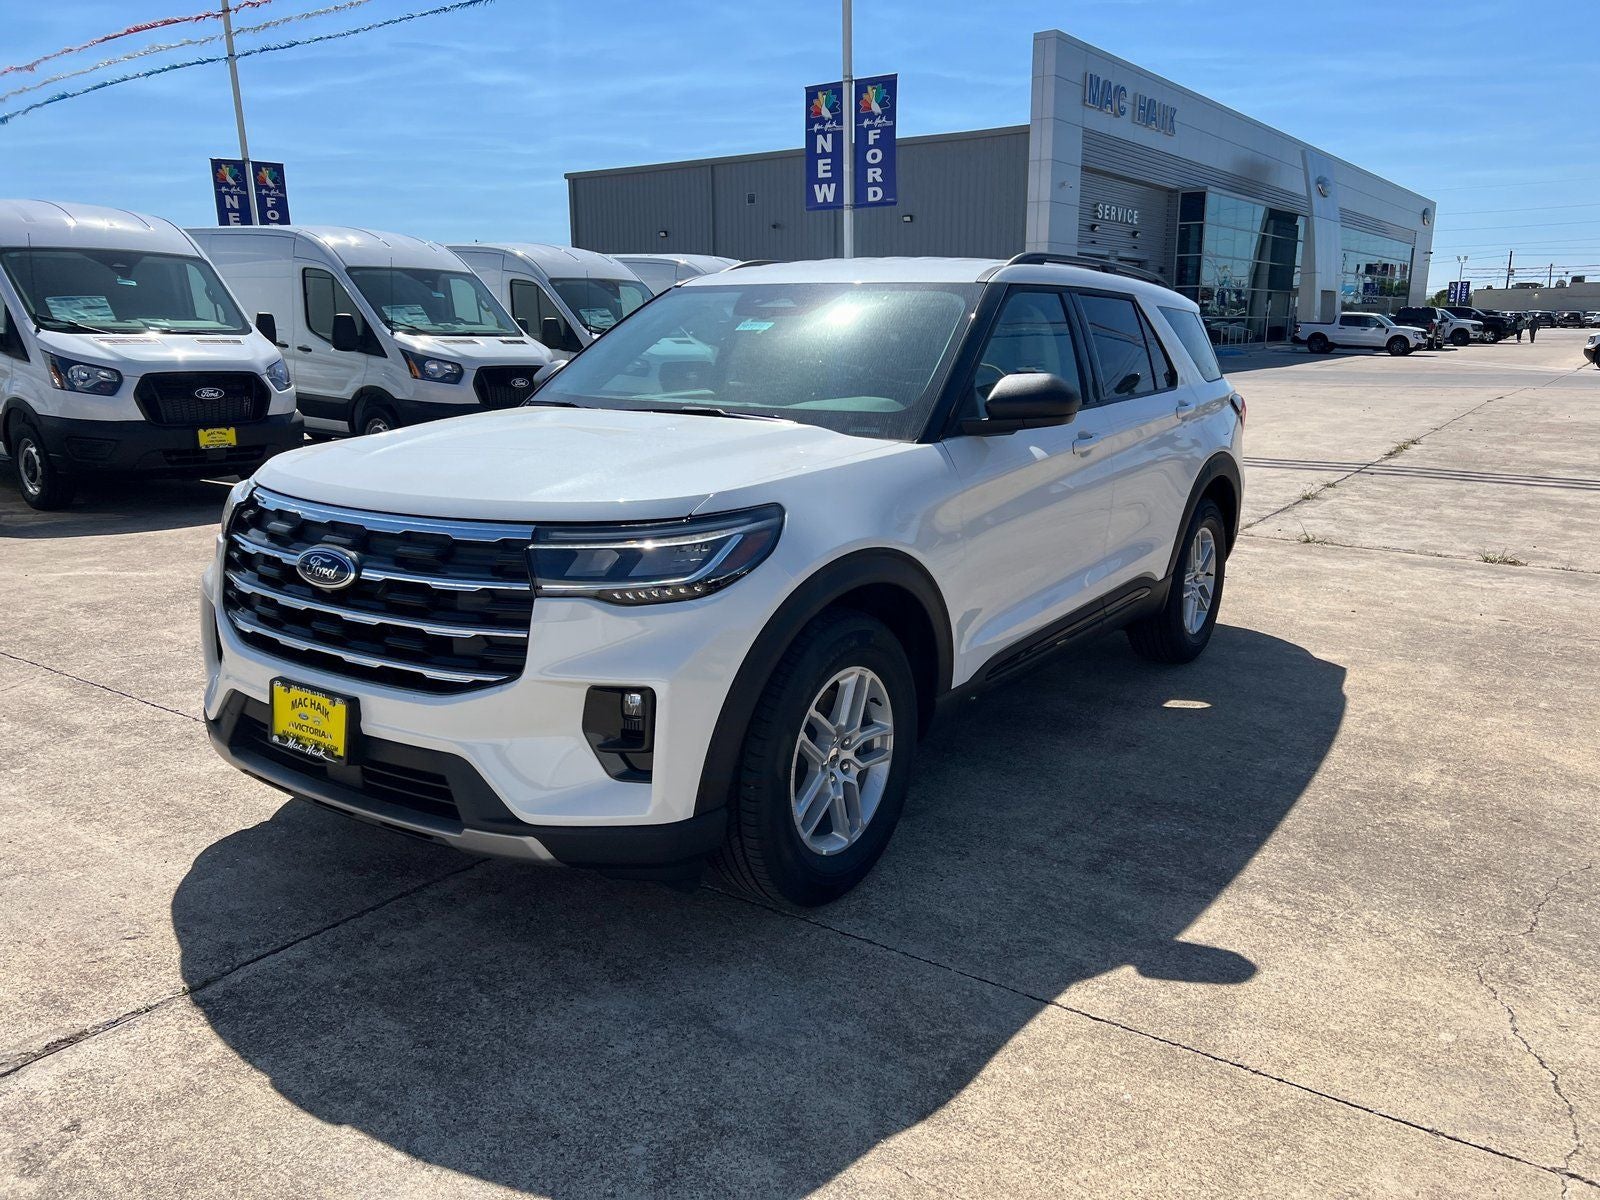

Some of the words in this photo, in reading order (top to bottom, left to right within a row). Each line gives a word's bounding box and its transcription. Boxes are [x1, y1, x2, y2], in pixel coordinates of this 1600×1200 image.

[1084, 72, 1127, 118] MAC
[1132, 92, 1178, 136] HAIK
[814, 133, 836, 203] NEW
[866, 129, 883, 202] FORD
[266, 197, 280, 226] FO
[1096, 203, 1139, 224] SERVICE
[201, 389, 219, 398] Ford
[306, 555, 339, 580] Ford
[291, 698, 308, 711] MAC
[310, 699, 330, 721] HAIK
[294, 721, 326, 738] VICTORIA
[285, 737, 304, 752] Mac
